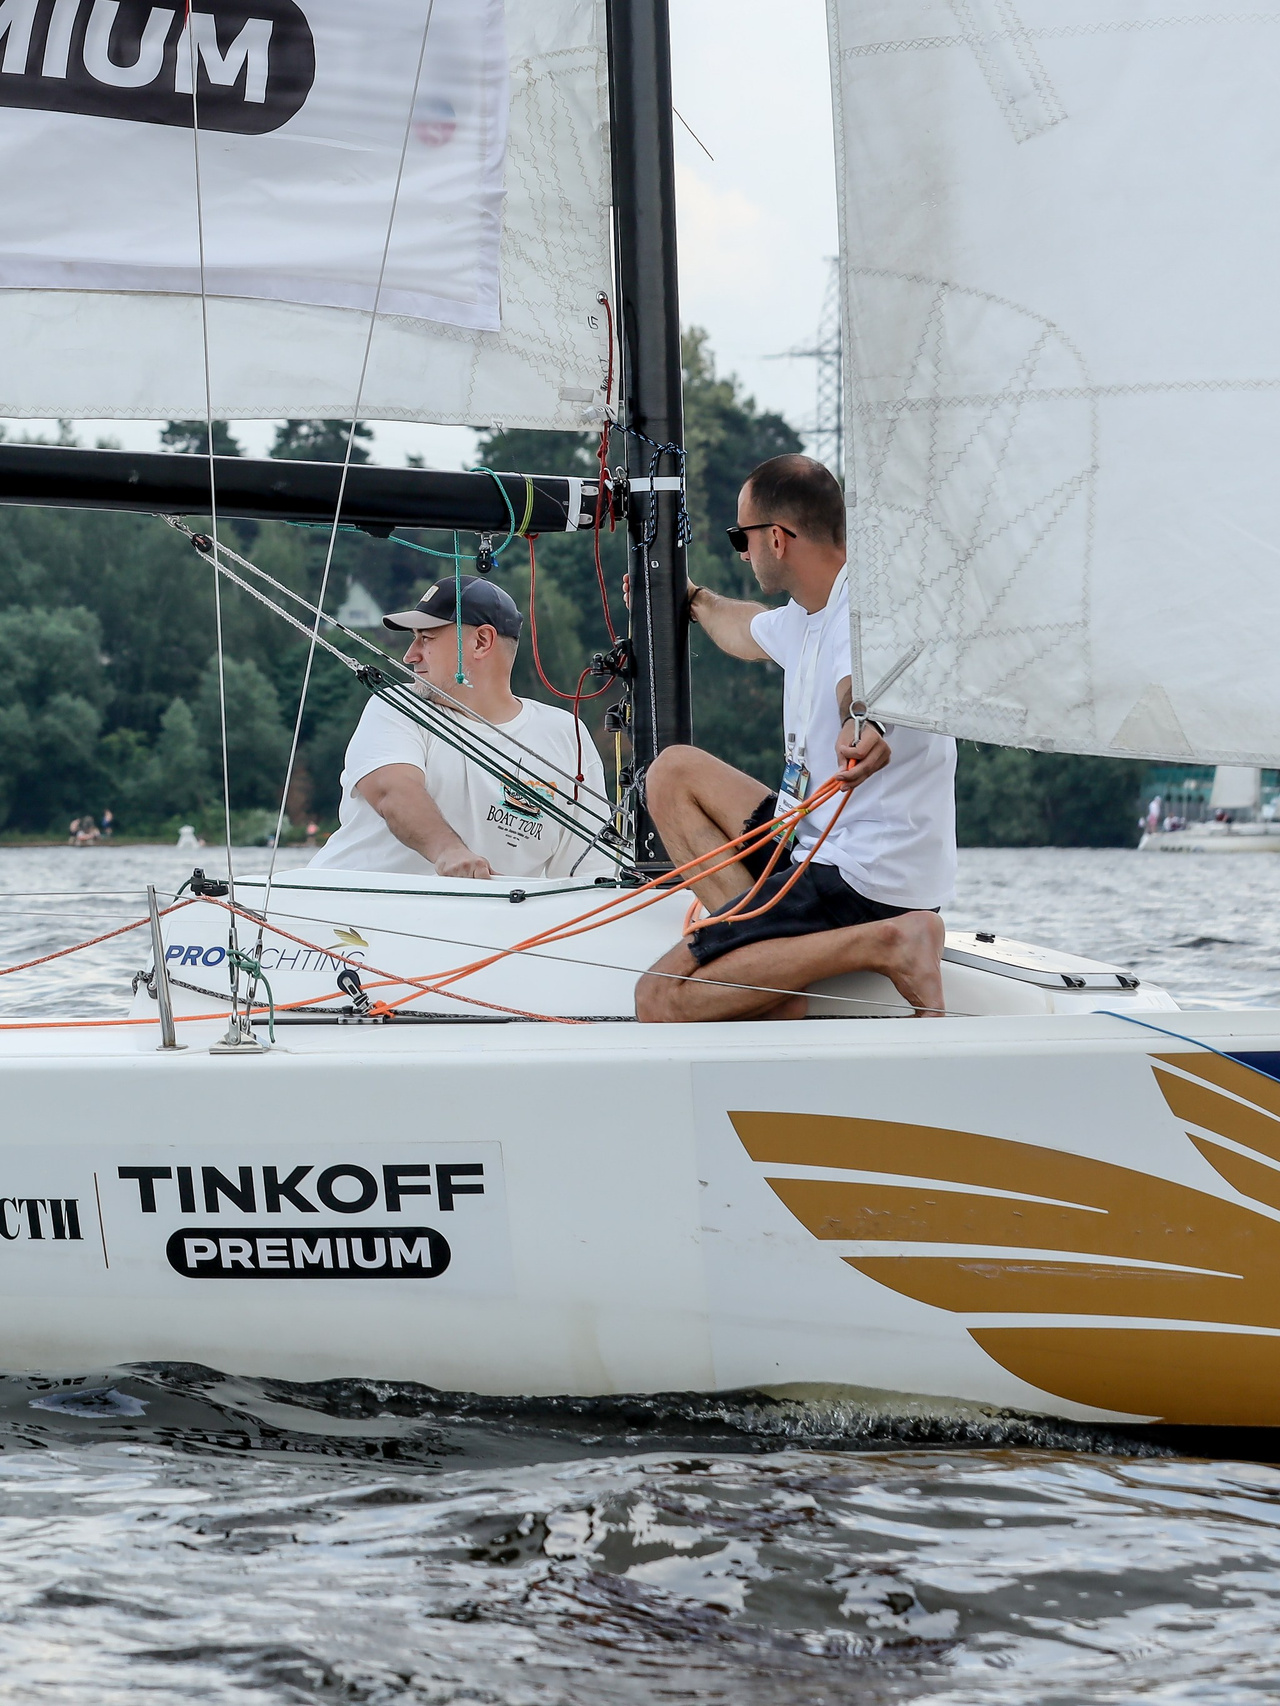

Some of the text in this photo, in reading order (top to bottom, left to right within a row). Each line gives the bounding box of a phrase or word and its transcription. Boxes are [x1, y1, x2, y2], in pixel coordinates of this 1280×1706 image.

[486, 804, 518, 827] BOAT
[518, 818, 543, 840] TOUR
[117, 1163, 485, 1214] TINKOFF
[183, 1237, 433, 1269] PREMIUM
